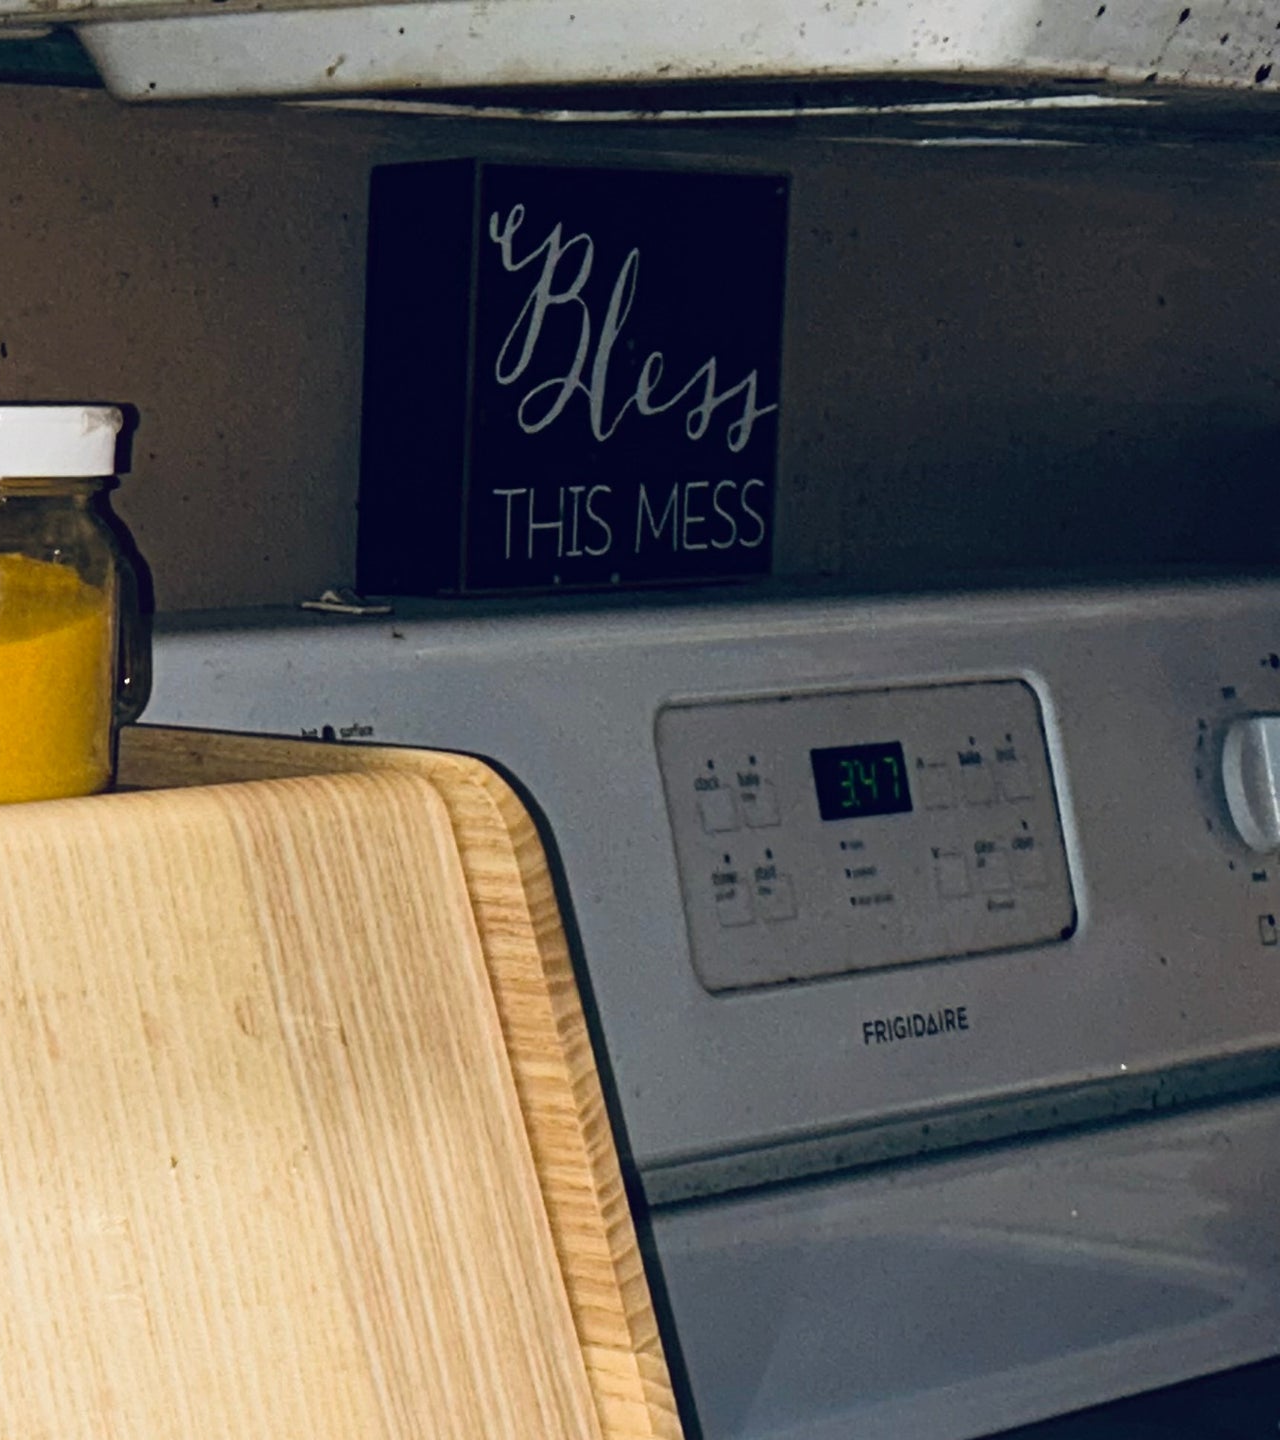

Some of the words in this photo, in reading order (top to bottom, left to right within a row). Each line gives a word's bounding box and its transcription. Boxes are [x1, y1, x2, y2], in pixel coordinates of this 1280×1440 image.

[490, 203, 778, 452] Bless
[493, 485, 612, 559] THIS
[635, 479, 765, 553] MESS
[862, 1006, 969, 1045] FRIGIDAIRE
